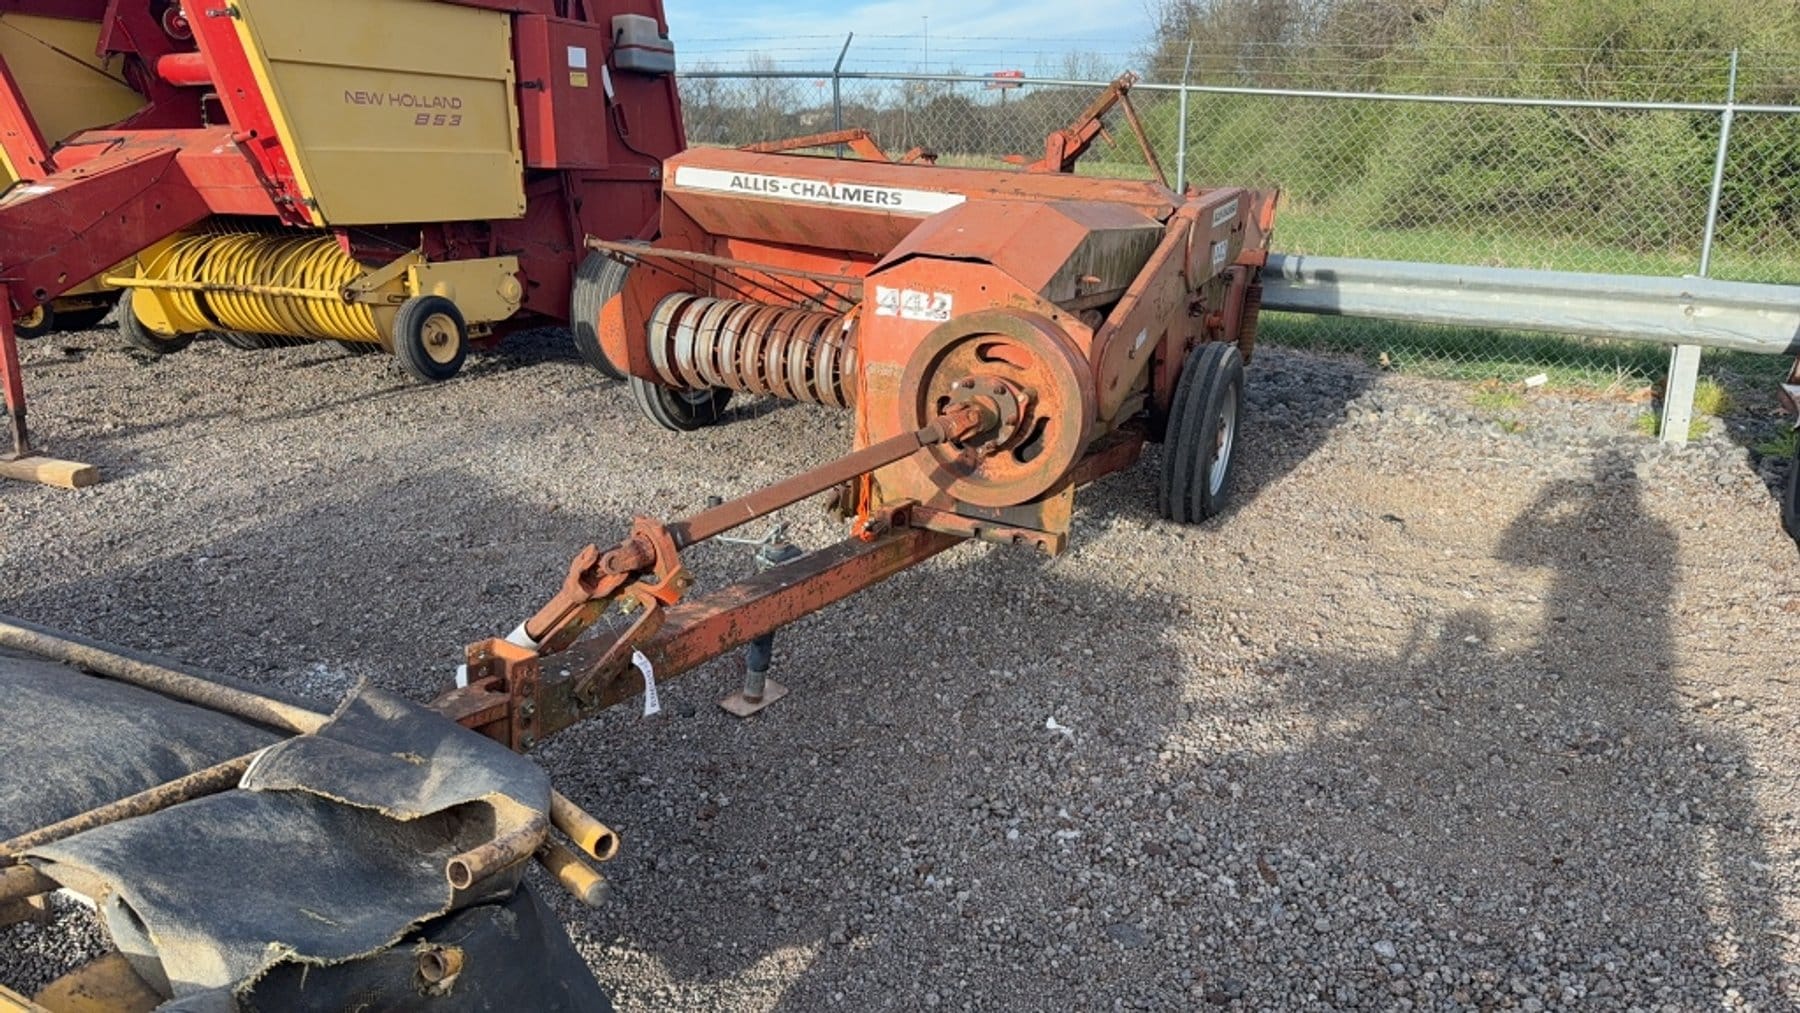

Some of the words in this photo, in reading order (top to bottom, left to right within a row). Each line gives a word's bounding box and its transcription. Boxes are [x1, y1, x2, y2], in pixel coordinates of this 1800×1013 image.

[344, 91, 384, 105] NEW
[388, 93, 462, 110] HOLLAND
[414, 113, 462, 126] 853
[730, 175, 903, 206] ALLIS-CHALMERS
